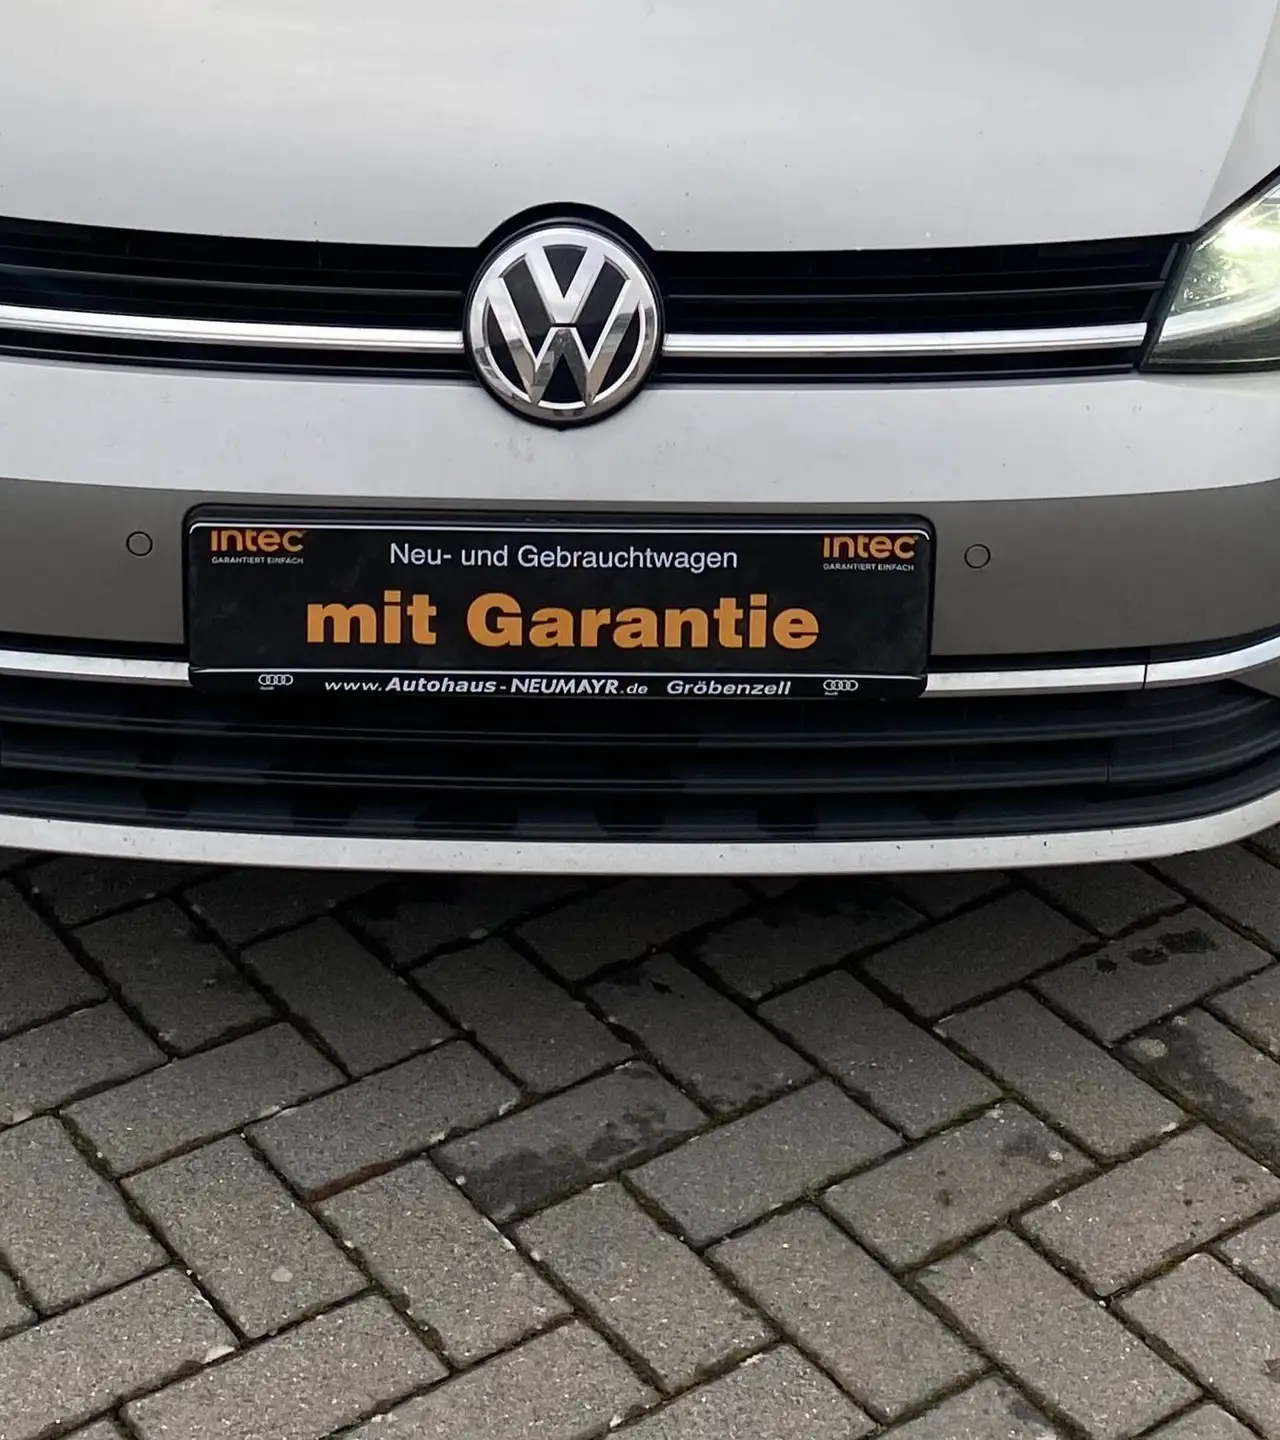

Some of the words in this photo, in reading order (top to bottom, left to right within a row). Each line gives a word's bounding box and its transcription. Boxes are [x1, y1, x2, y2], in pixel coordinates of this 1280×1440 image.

[211, 556, 265, 564] GARANTIERT
[267, 557, 304, 565] EINFACH
[389, 543, 452, 566] Neu-
[461, 545, 508, 567] und
[517, 544, 738, 574] Gebrauchtwagen
[823, 563, 876, 571] GARANTIERT
[877, 563, 914, 572] EINFACH
[307, 589, 437, 645] mit
[466, 591, 819, 650] Garantie
[666, 679, 792, 696] Gröbenzell
